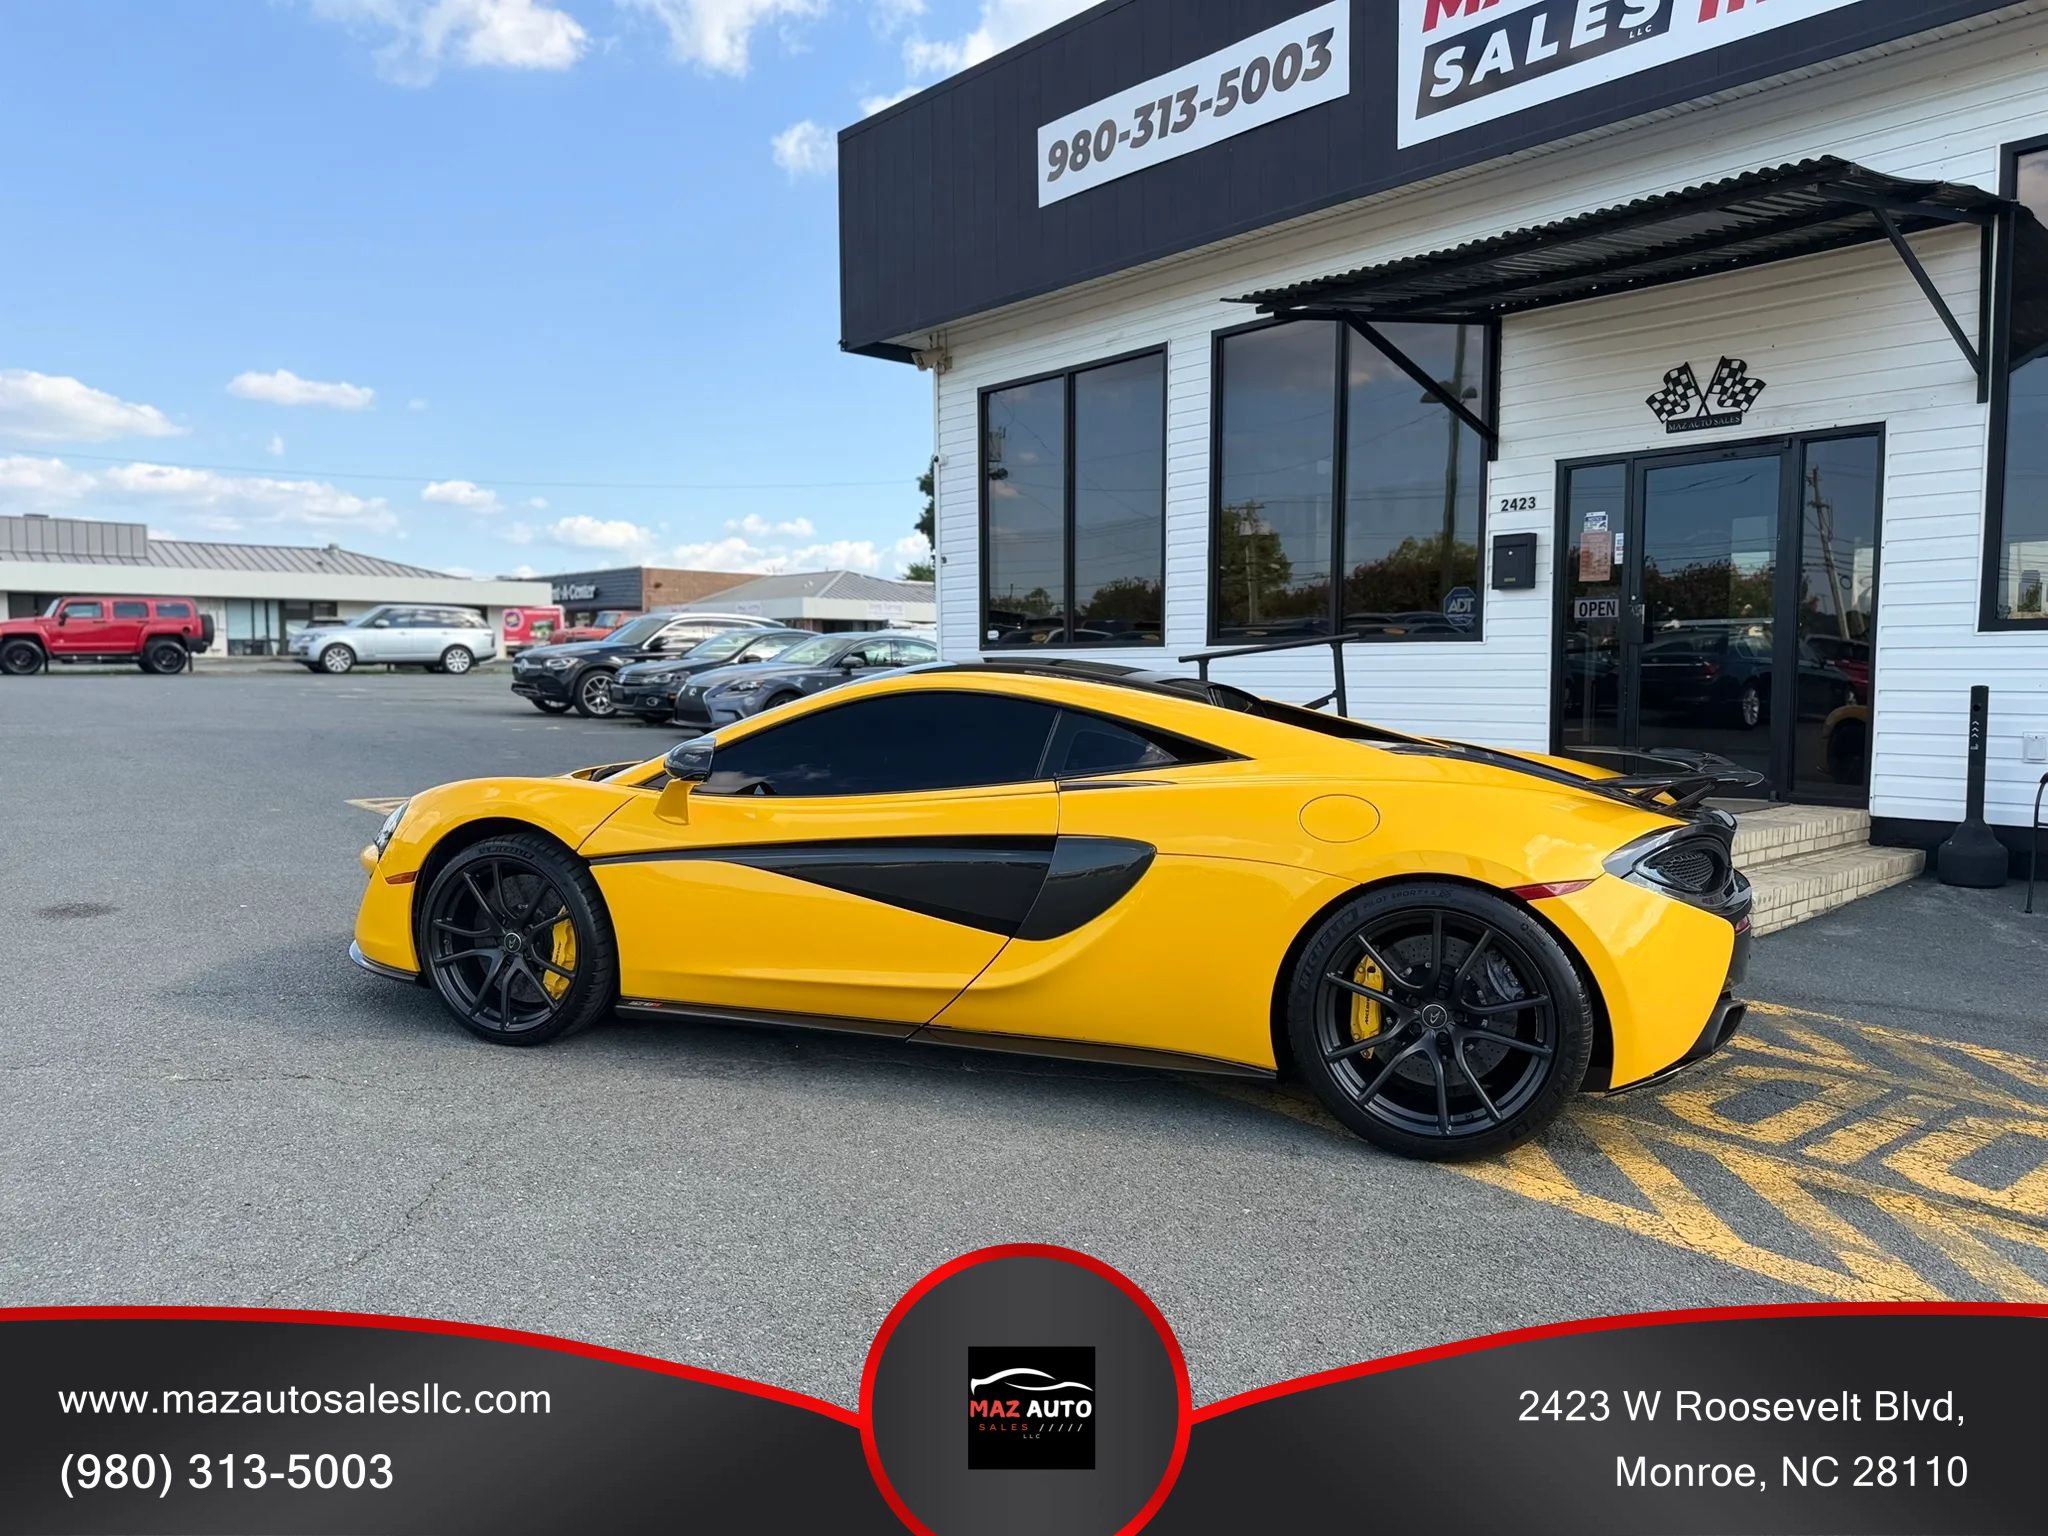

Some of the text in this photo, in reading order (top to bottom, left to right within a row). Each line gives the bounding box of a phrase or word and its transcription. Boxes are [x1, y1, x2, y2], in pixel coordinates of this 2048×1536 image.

[1629, 25, 1653, 39] LLC
[1429, 0, 1660, 98] SALES
[1047, 27, 1335, 182] 980-313-5003
[1668, 416, 1740, 431] MAZ AUTO SALES
[1501, 497, 1536, 512] 2423
[1447, 598, 1475, 613] ADT
[1579, 601, 1616, 617] OPEN
